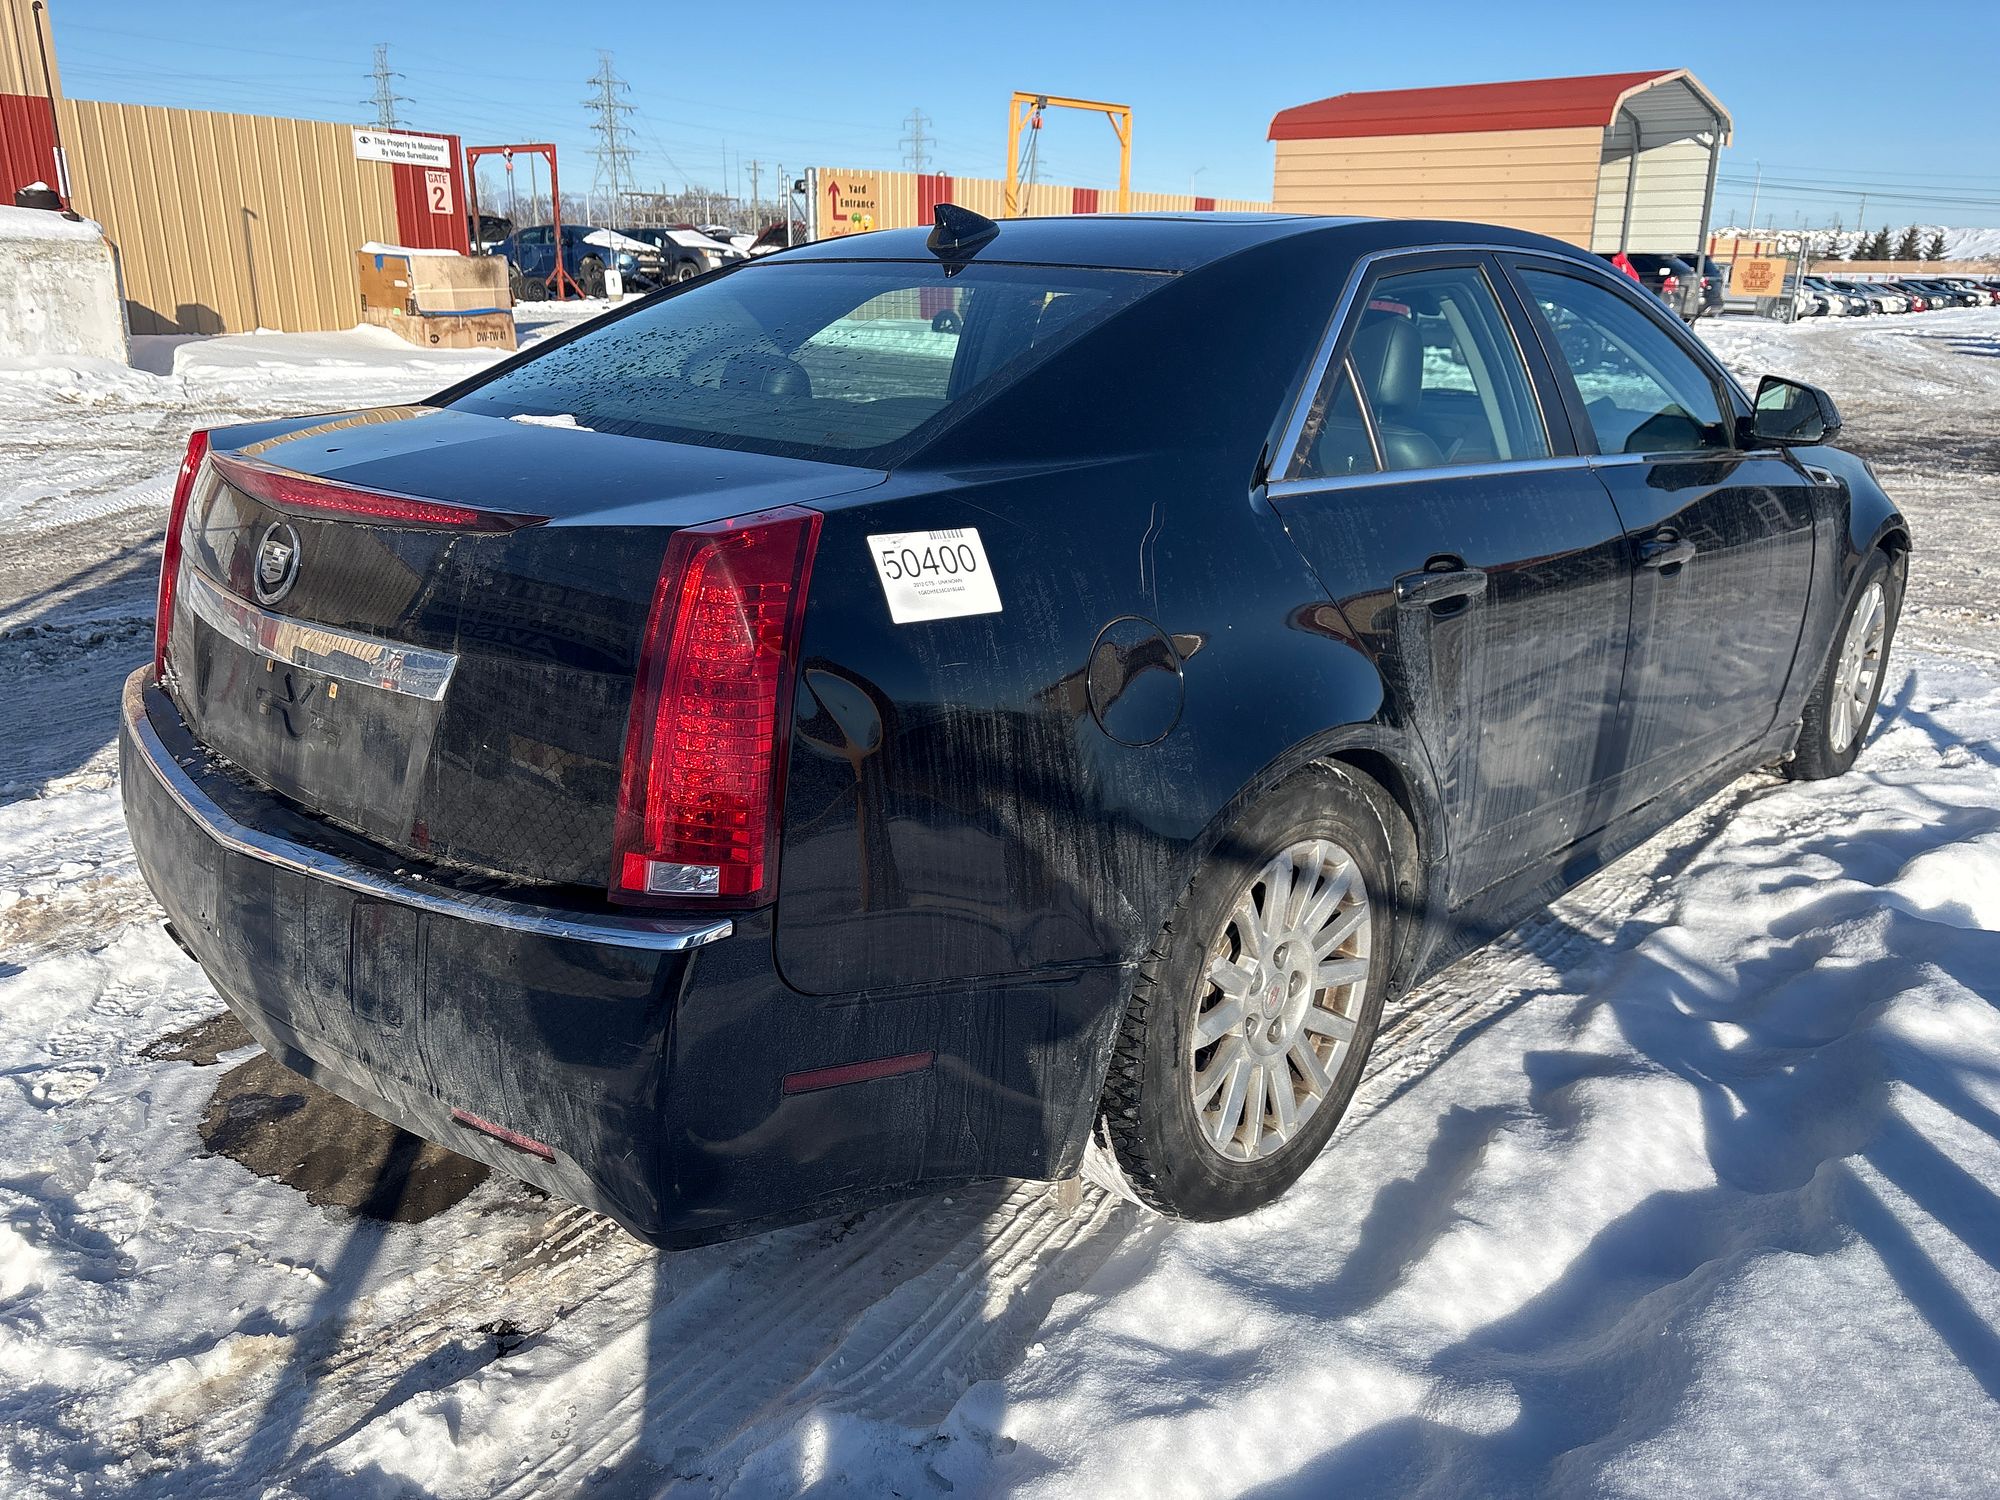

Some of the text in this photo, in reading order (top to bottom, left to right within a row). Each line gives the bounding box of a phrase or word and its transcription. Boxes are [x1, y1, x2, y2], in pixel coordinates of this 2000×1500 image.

[374, 137, 444, 152] This Property Is Monitored
[381, 148, 439, 161] By Video Surveillance
[428, 173, 447, 184] GATE
[849, 184, 867, 194] Yard
[433, 186, 446, 211] 2
[840, 198, 875, 209] Entrance
[611, 277, 616, 288] 1
[476, 331, 506, 342] DW-TW 41
[882, 544, 977, 580] 50400
